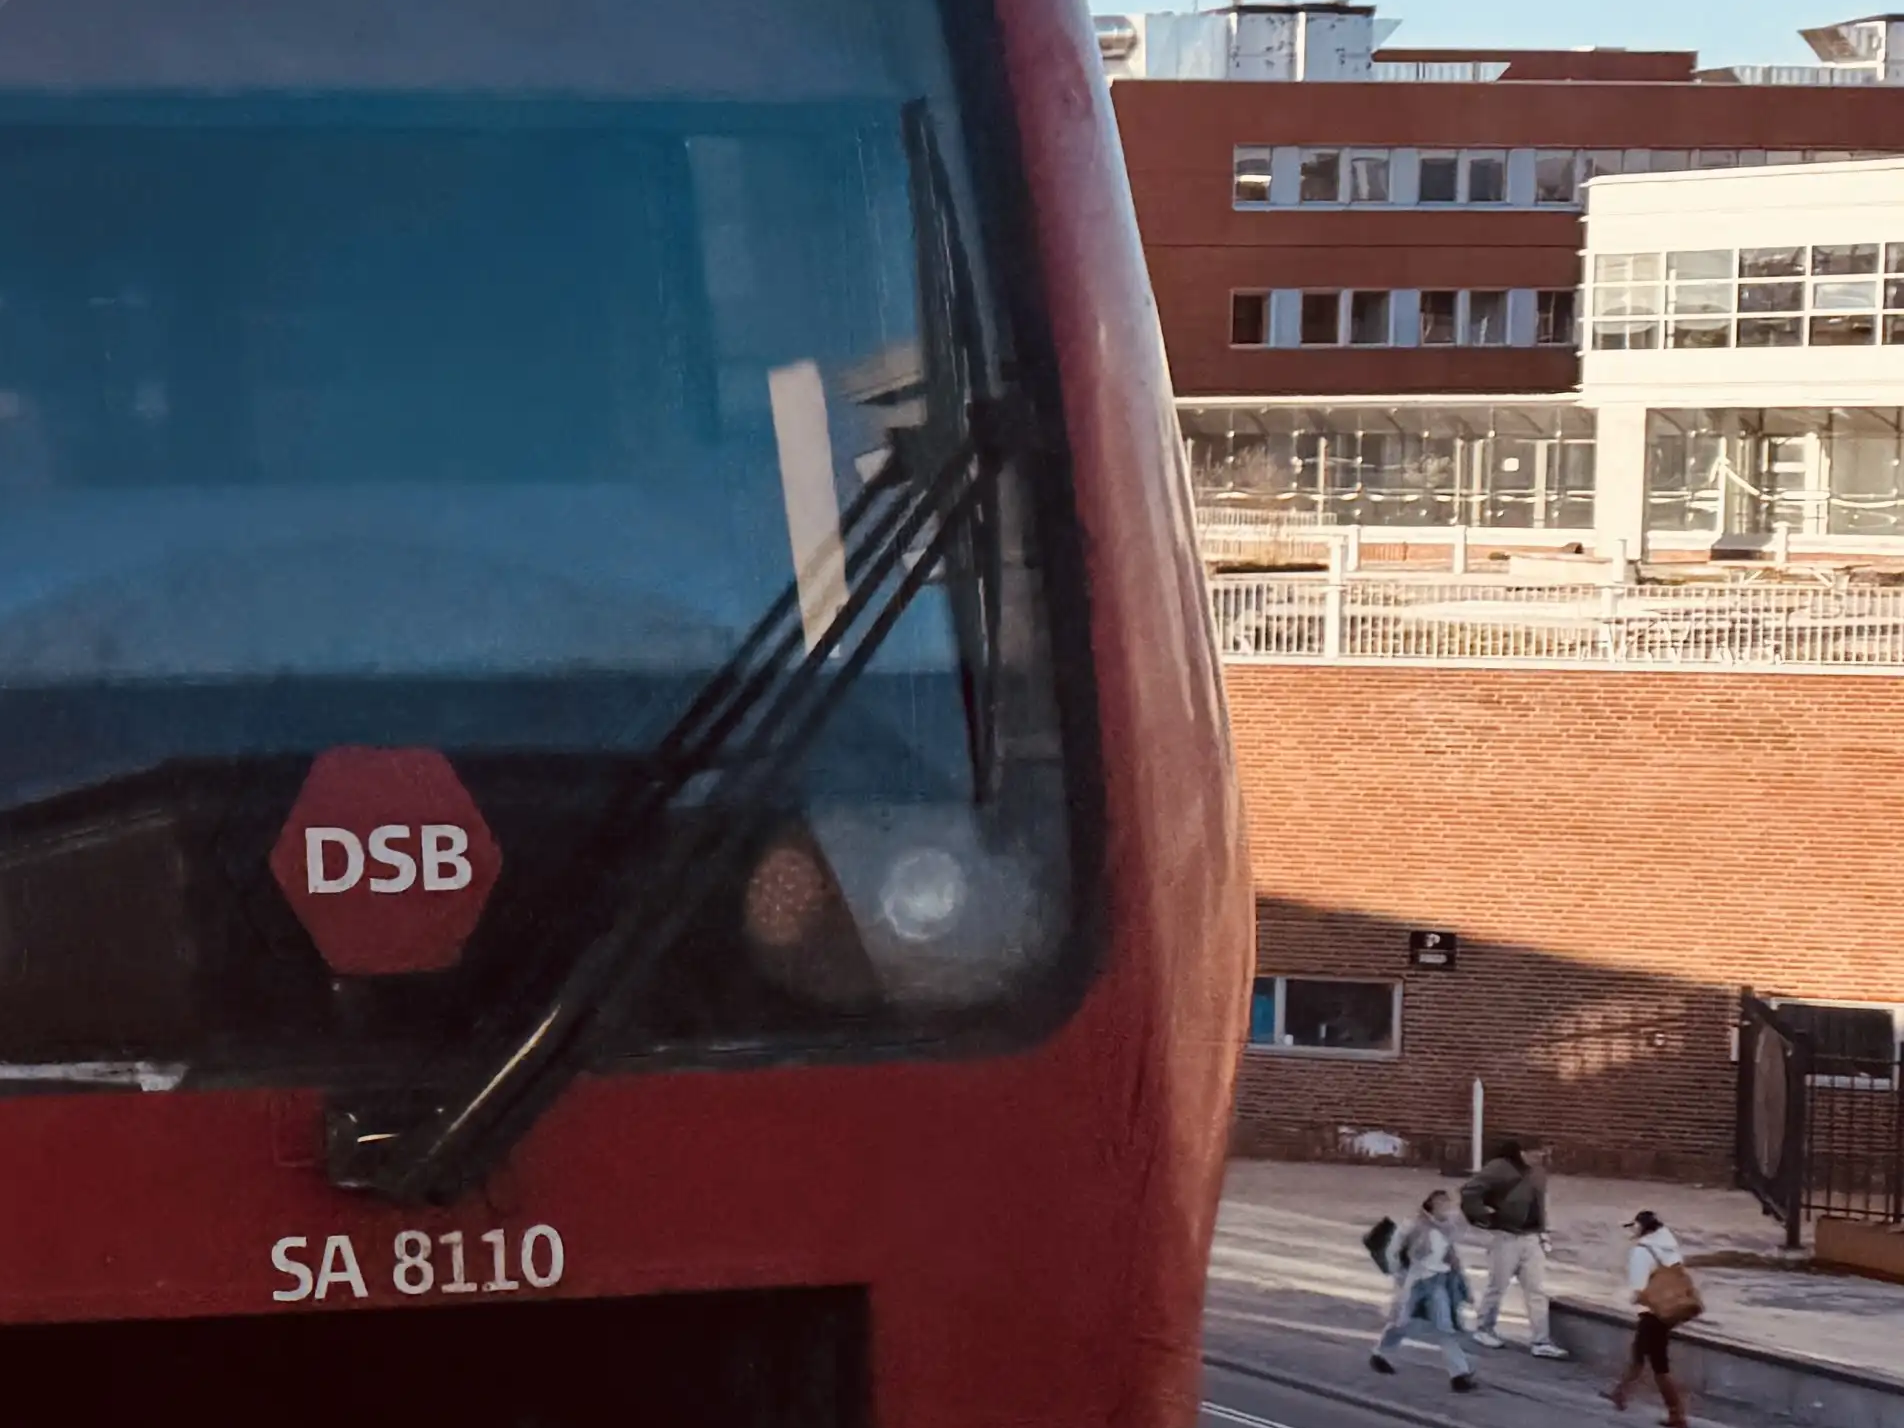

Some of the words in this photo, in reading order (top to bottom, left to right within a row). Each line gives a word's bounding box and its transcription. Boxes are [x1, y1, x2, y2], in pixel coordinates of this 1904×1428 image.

[305, 824, 472, 894] DSB
[271, 1235, 369, 1301] SA
[393, 1224, 564, 1295] 8110
